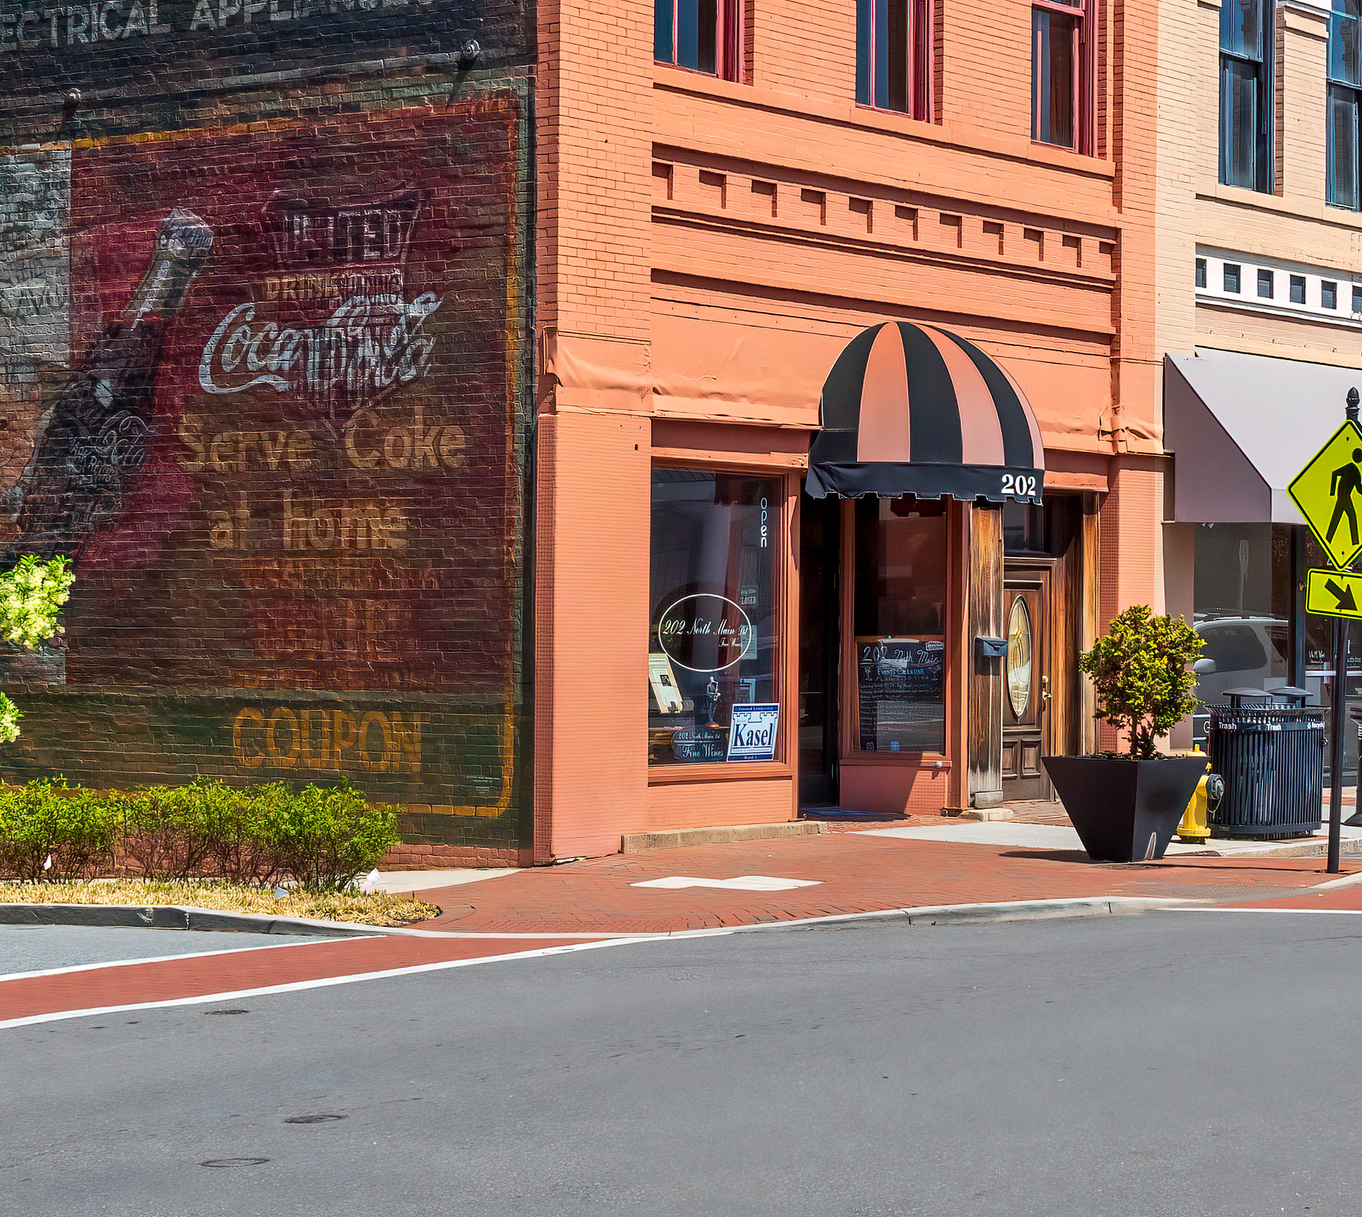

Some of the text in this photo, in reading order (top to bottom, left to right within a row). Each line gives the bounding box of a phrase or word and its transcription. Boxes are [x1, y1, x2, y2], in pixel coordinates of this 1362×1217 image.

[178, 415, 316, 472] Serve
[341, 405, 466, 469] Coke
[1000, 473, 1036, 496] 202
[209, 488, 409, 550] at home
[662, 619, 686, 635] 202
[686, 617, 712, 636] North
[712, 618, 735, 636] Main
[733, 722, 774, 748] Kasel
[1218, 721, 1237, 731] Trash
[1266, 723, 1282, 732] Trash
[231, 705, 424, 773] COUPON
[682, 743, 724, 758] Fine Wines
